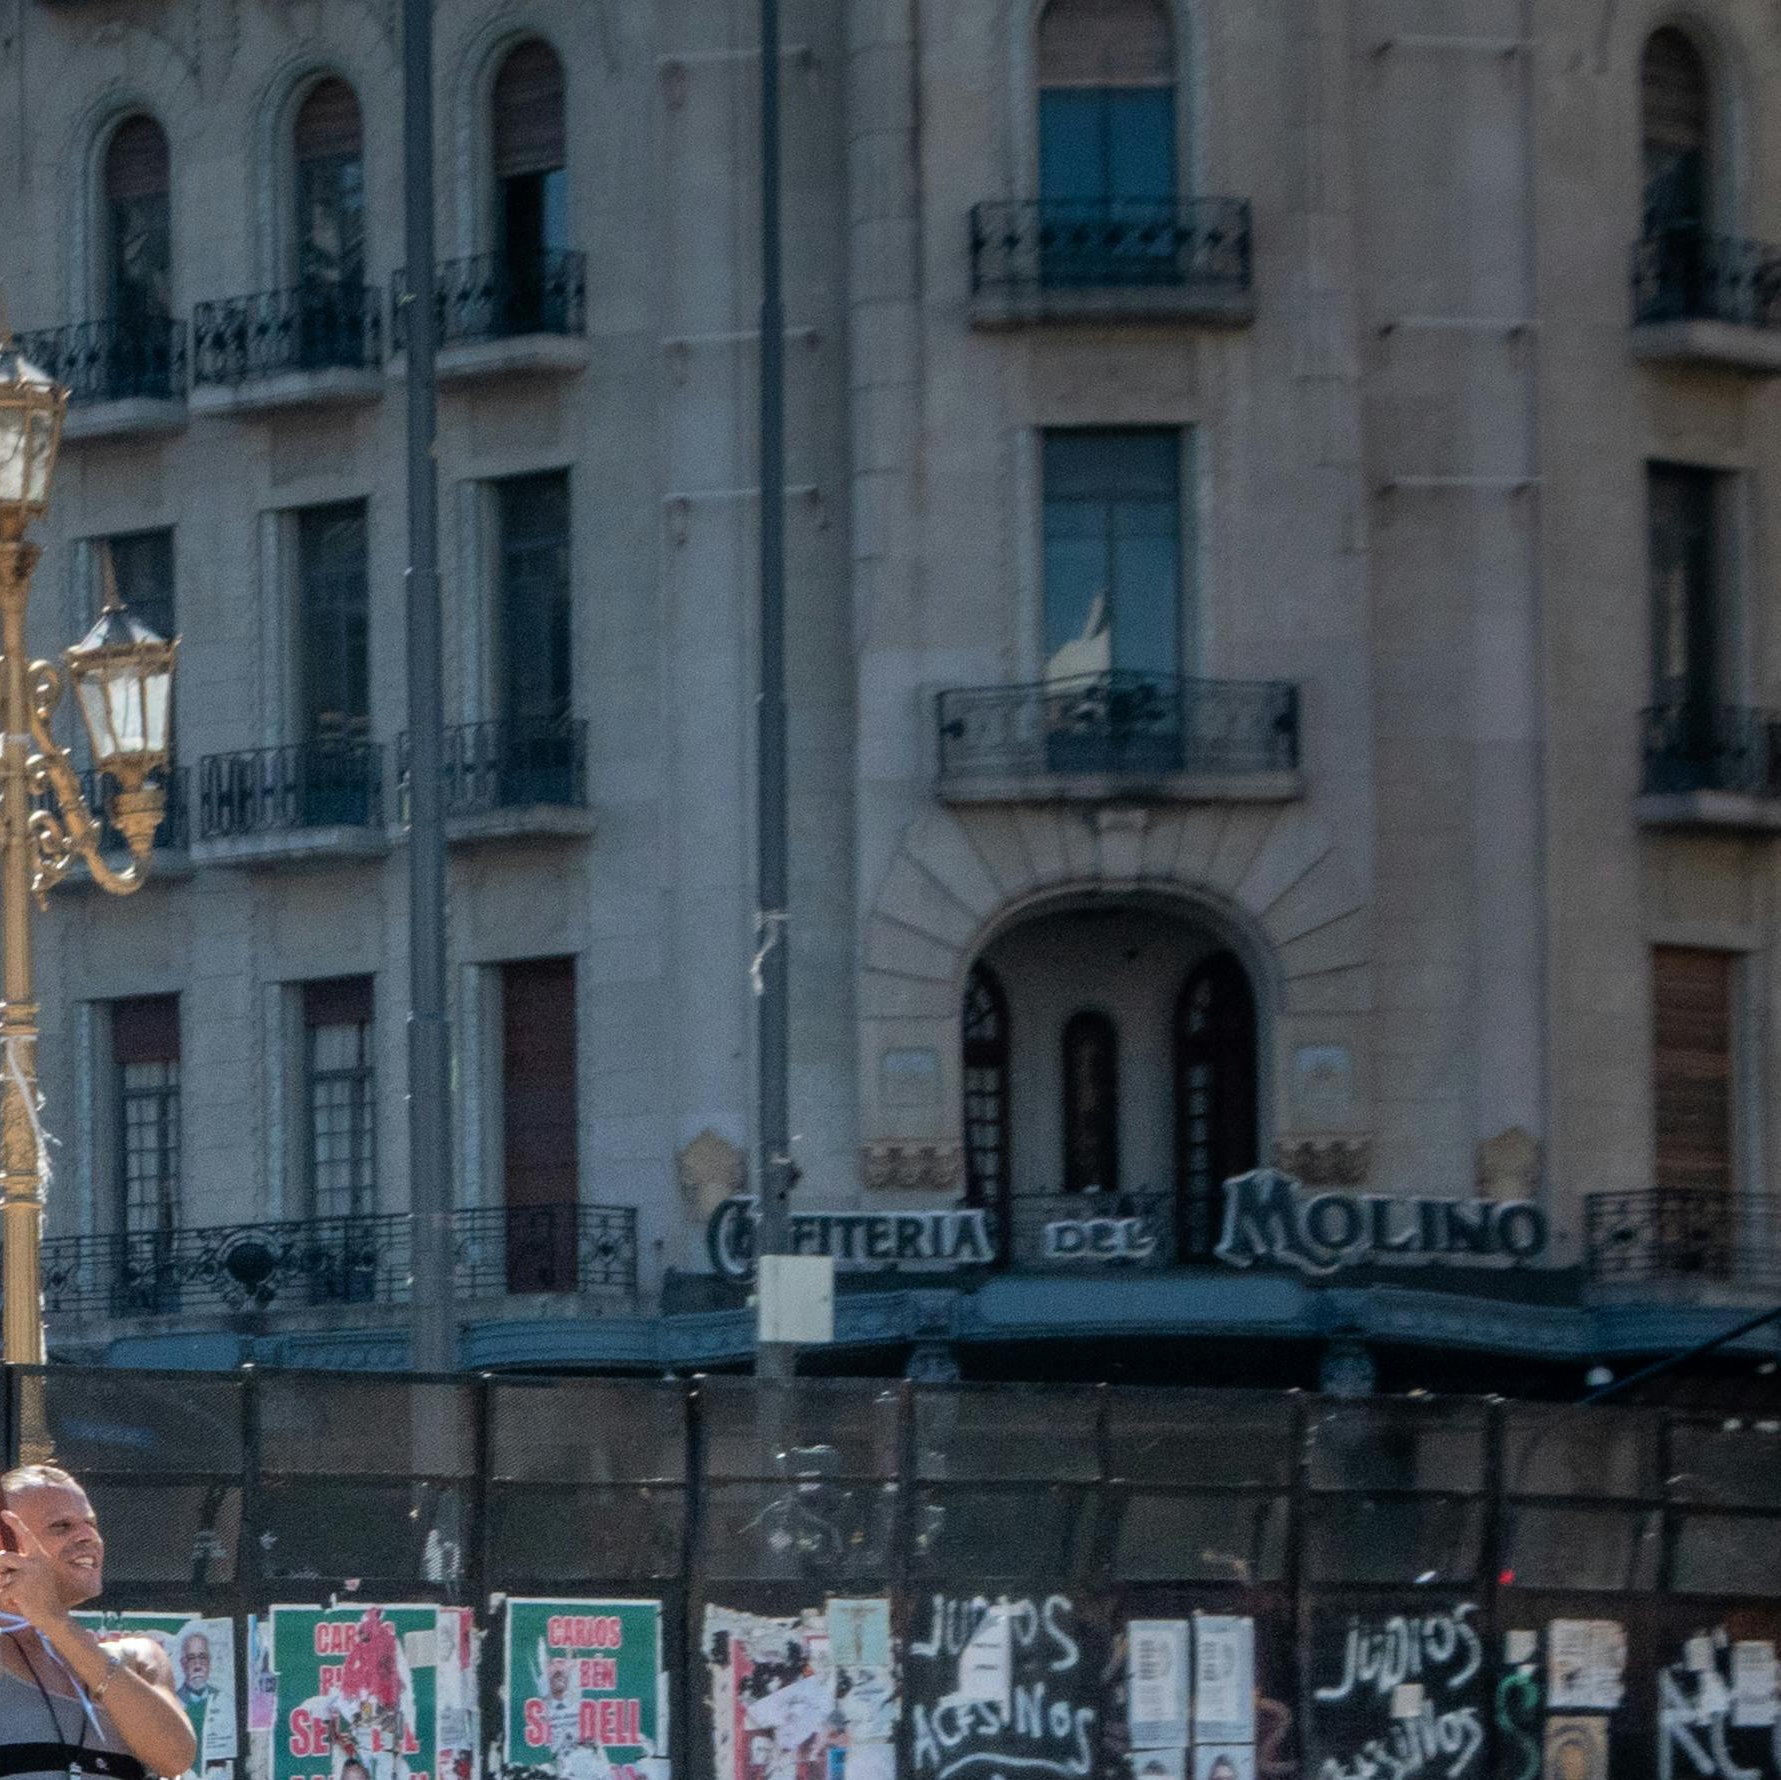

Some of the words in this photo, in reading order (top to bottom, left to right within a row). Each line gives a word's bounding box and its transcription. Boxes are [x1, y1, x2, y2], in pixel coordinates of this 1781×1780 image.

[1045, 1218, 1154, 1259] DEL
[1214, 1168, 1549, 1275] MOLINO
[548, 1616, 621, 1649] CARLOS
